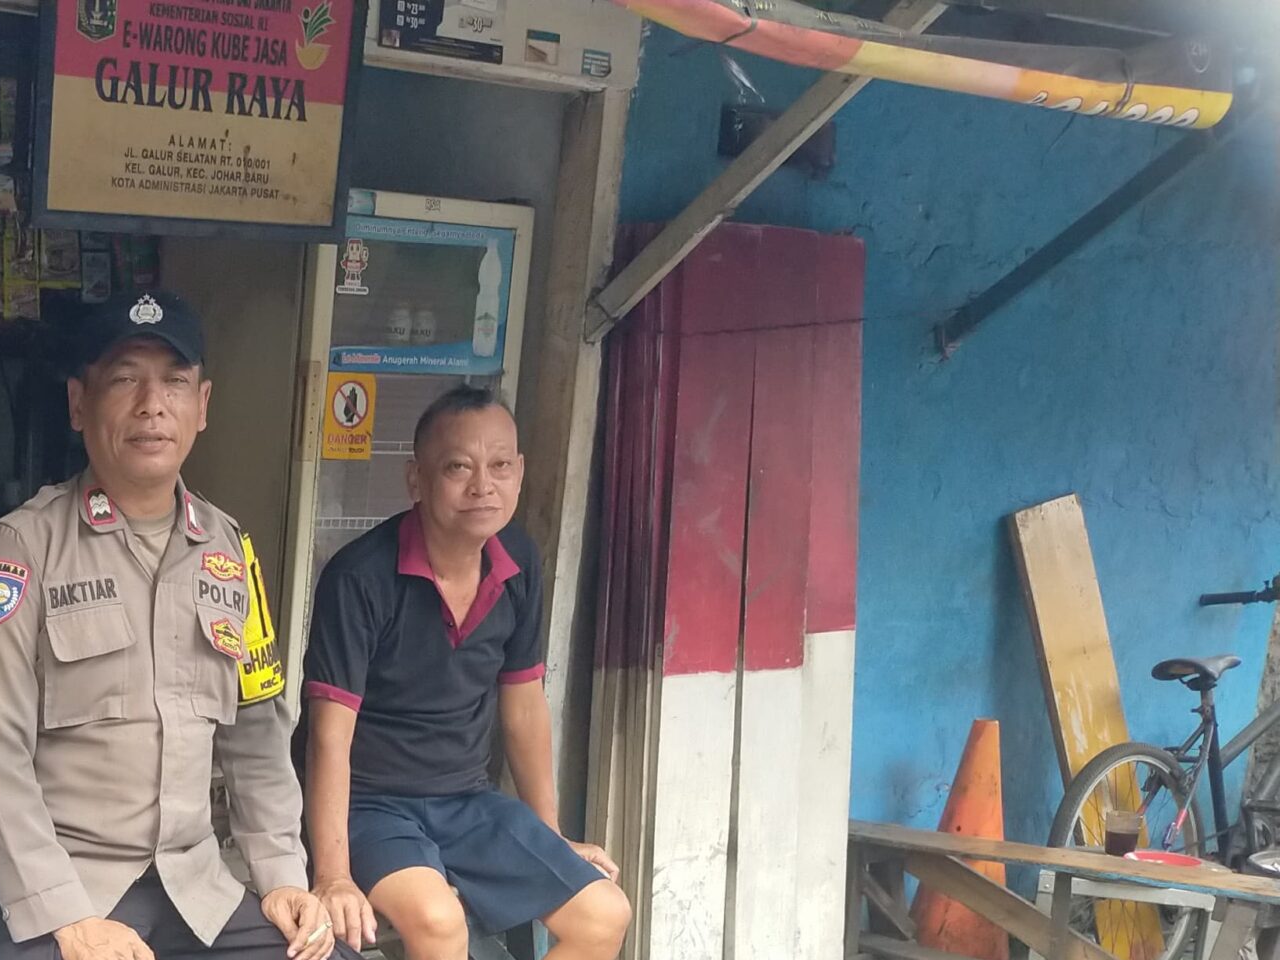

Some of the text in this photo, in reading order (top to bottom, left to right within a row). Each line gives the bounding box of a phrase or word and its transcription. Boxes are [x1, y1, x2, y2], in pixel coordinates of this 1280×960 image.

[149, 3, 269, 32] KEMENTERIAN SOSIAL RI
[122, 20, 288, 67] E-WARONG KUBE JASA
[95, 57, 307, 122] GALUR RAYA
[124, 147, 138, 159] JL.
[141, 149, 173, 162] GALUR
[176, 151, 217, 166] SELATAN
[220, 155, 233, 167] RT.
[124, 162, 270, 185] KEL. GALUR, KEC. JOHAR BARU
[111, 176, 280, 201] KOTA ADMINISTRASI JAKARTA PUSAT
[382, 355, 418, 367] Anugerah
[420, 356, 447, 367] Mineral
[327, 433, 367, 446] DANGER
[48, 577, 118, 609] BAKTIAR
[198, 579, 245, 616] POLRI
